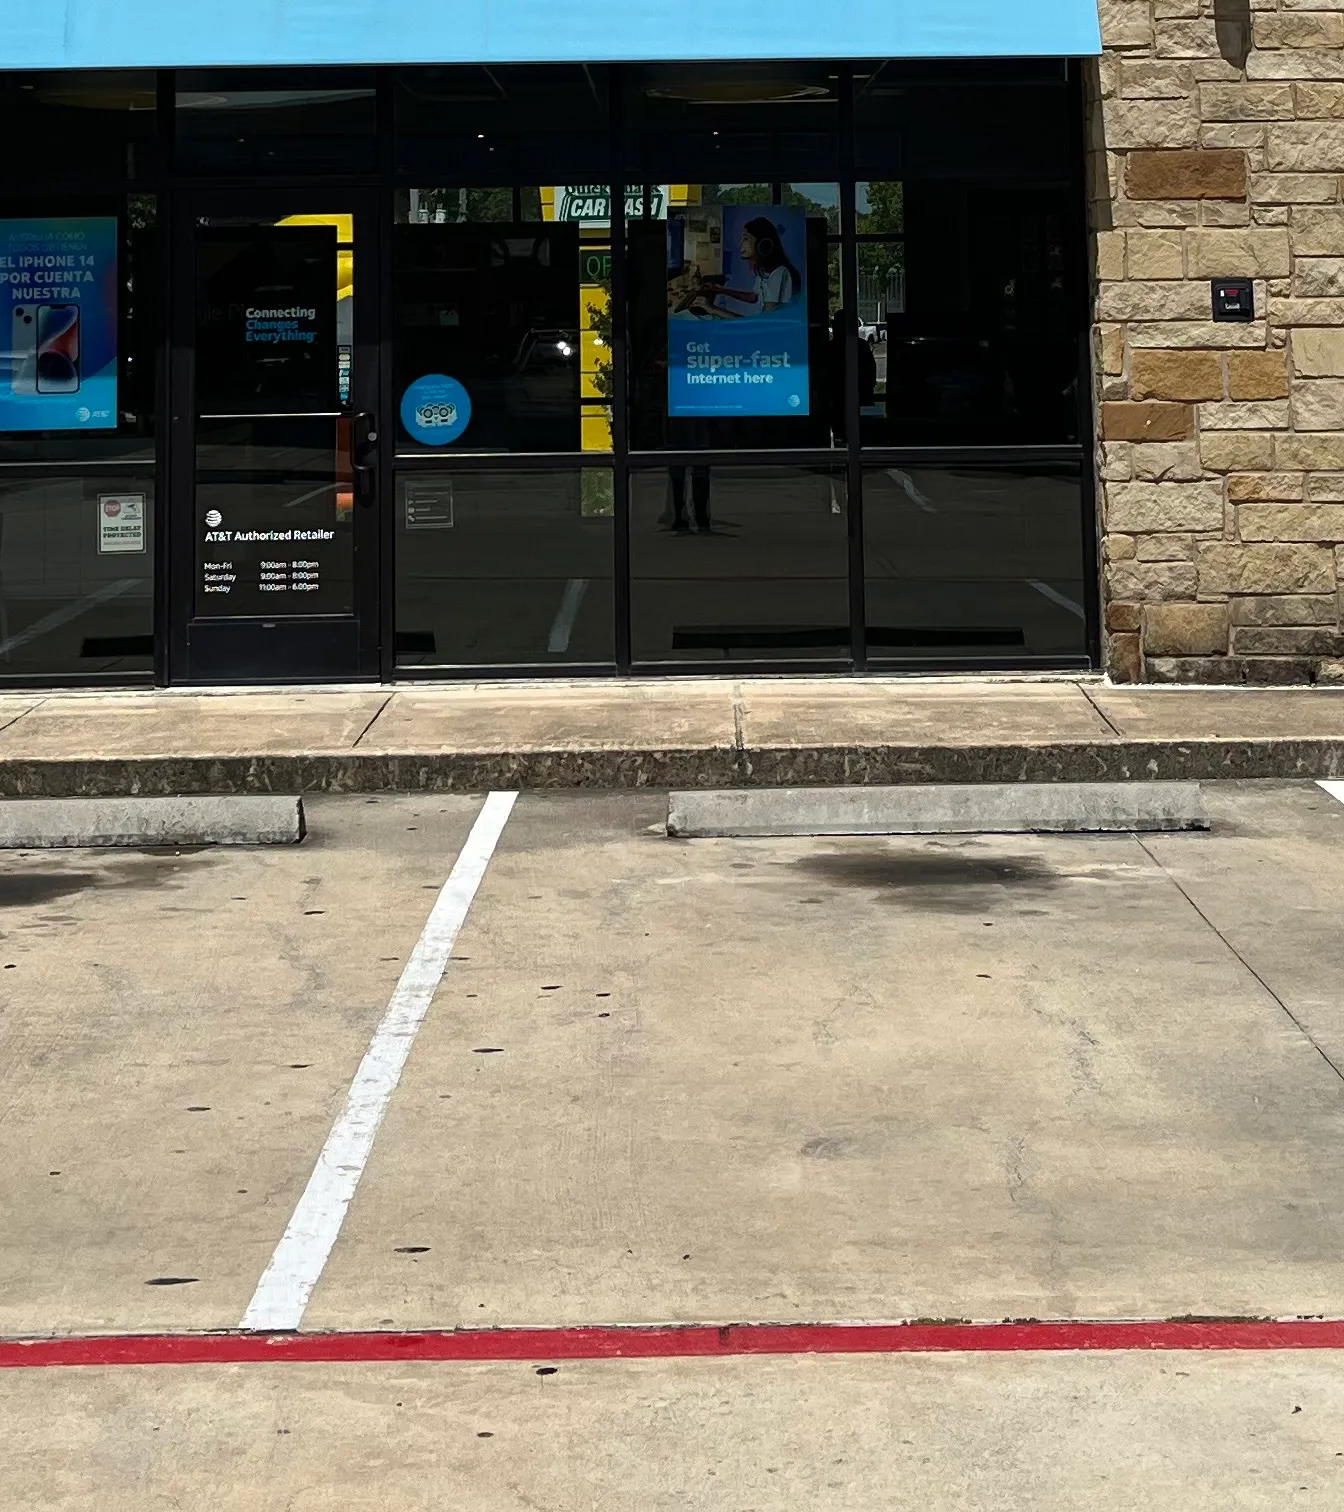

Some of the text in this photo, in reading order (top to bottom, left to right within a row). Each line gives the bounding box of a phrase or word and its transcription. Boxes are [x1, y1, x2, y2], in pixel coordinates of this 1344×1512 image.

[570, 198, 607, 217] CAR
[0, 255, 95, 268] EL IPHONE 14
[0, 270, 95, 284] POR CUENTA
[12, 287, 81, 300] NUESTRA
[245, 306, 316, 320] Connecting
[245, 319, 299, 332] Changes
[245, 330, 316, 344] Everything
[686, 341, 710, 353] Get
[686, 350, 792, 373] super-fast
[686, 372, 774, 384] Internet here
[105, 504, 121, 512] STOP
[205, 529, 334, 542] AT&T Authorized Retailer
[204, 562, 233, 570] Mon-Fri
[204, 573, 236, 582] Saturday
[204, 584, 231, 593] Sunday
